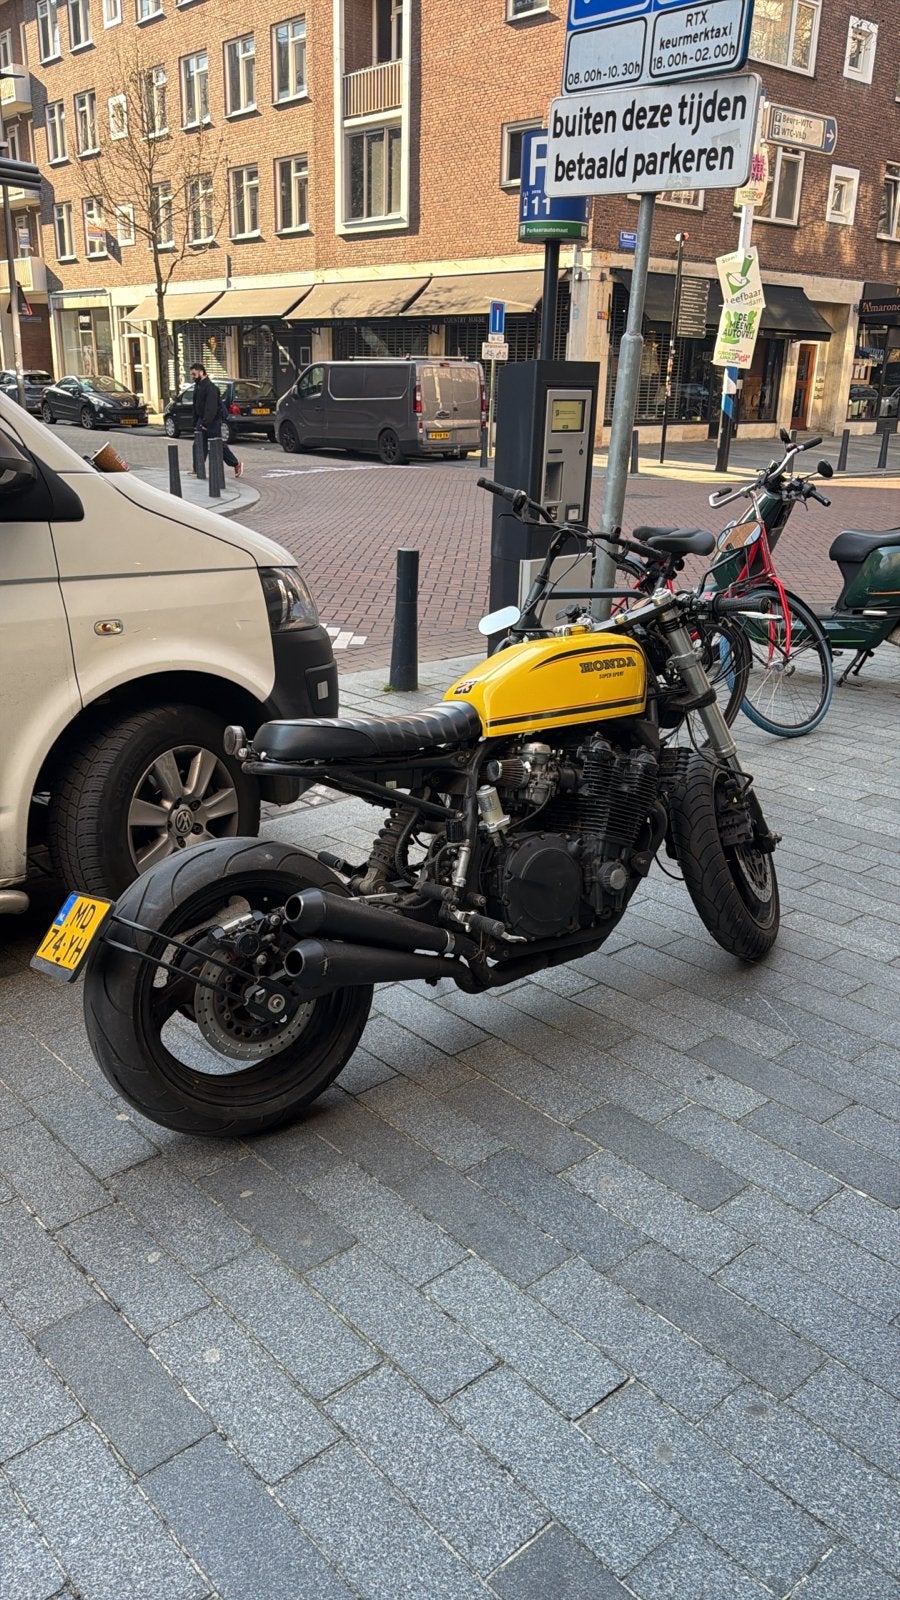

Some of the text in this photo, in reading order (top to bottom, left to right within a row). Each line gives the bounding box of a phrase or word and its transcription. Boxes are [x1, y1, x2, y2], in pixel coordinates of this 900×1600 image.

[686, 10, 708, 27] RTX
[660, 23, 732, 51] keurmerktaxi
[552, 89, 747, 138] buiten deze tijden
[555, 142, 734, 183] betaald parkeren
[532, 196, 550, 216] 11
[579, 656, 637, 674] HONDA
